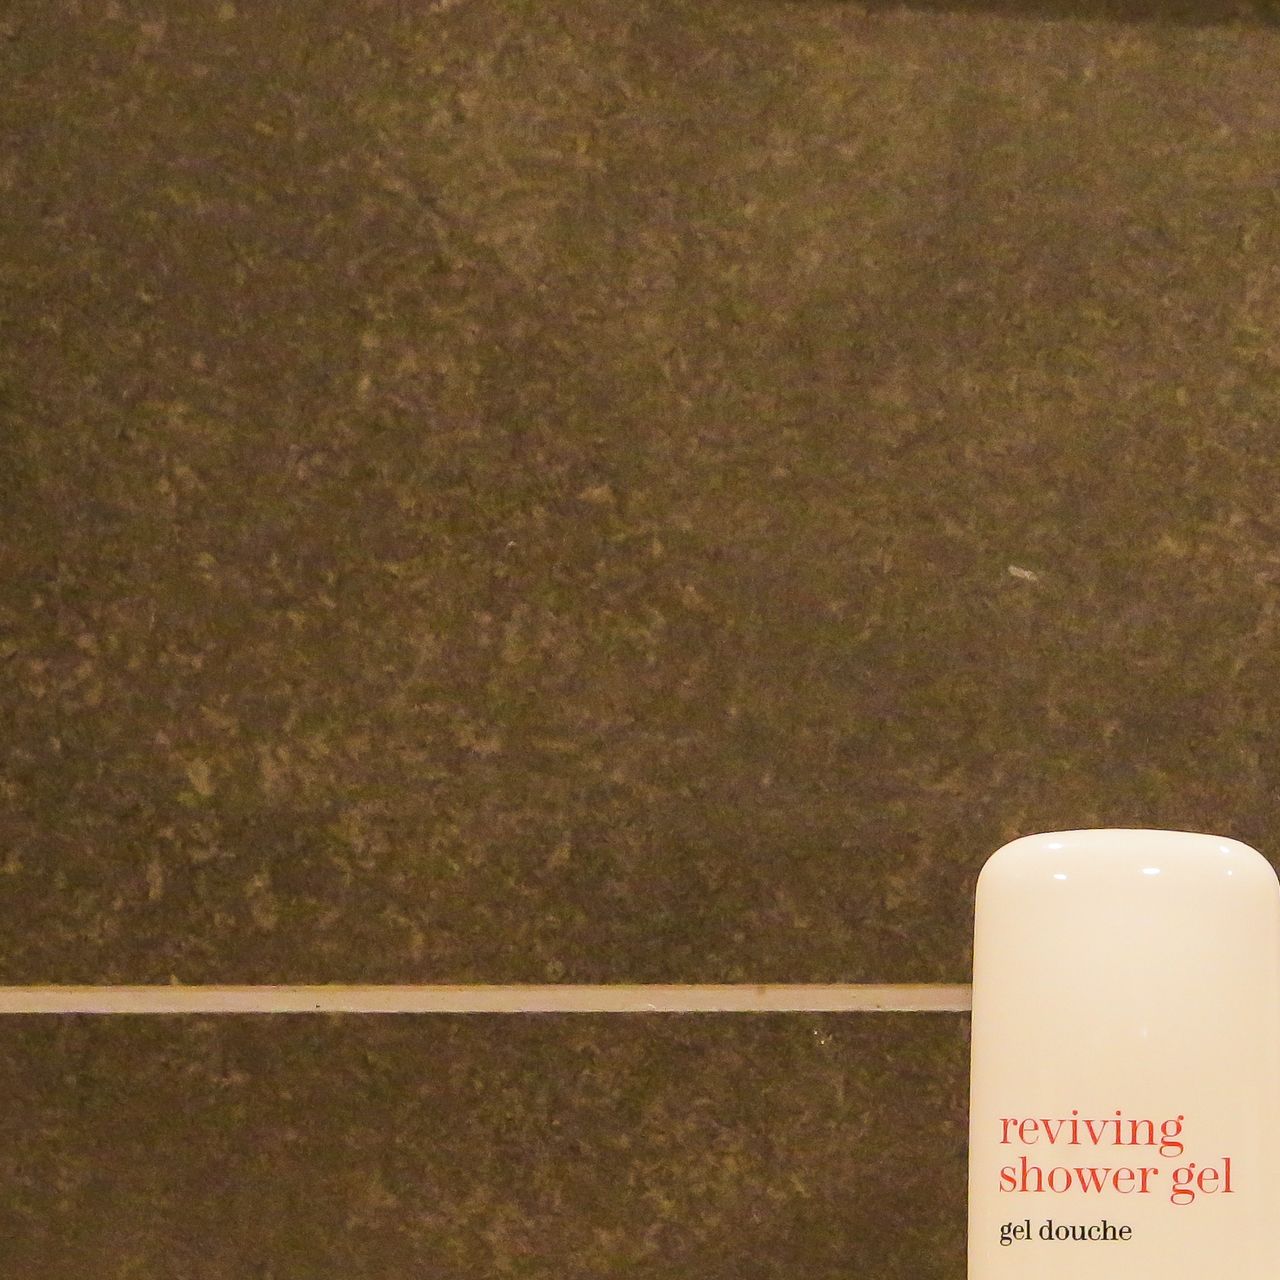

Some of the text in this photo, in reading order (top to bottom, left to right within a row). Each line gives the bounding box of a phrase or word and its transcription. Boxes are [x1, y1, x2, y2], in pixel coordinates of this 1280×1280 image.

[999, 1110, 1185, 1157] reviving
[999, 1156, 1235, 1206] shower gel
[999, 1219, 1132, 1247] gel douche
